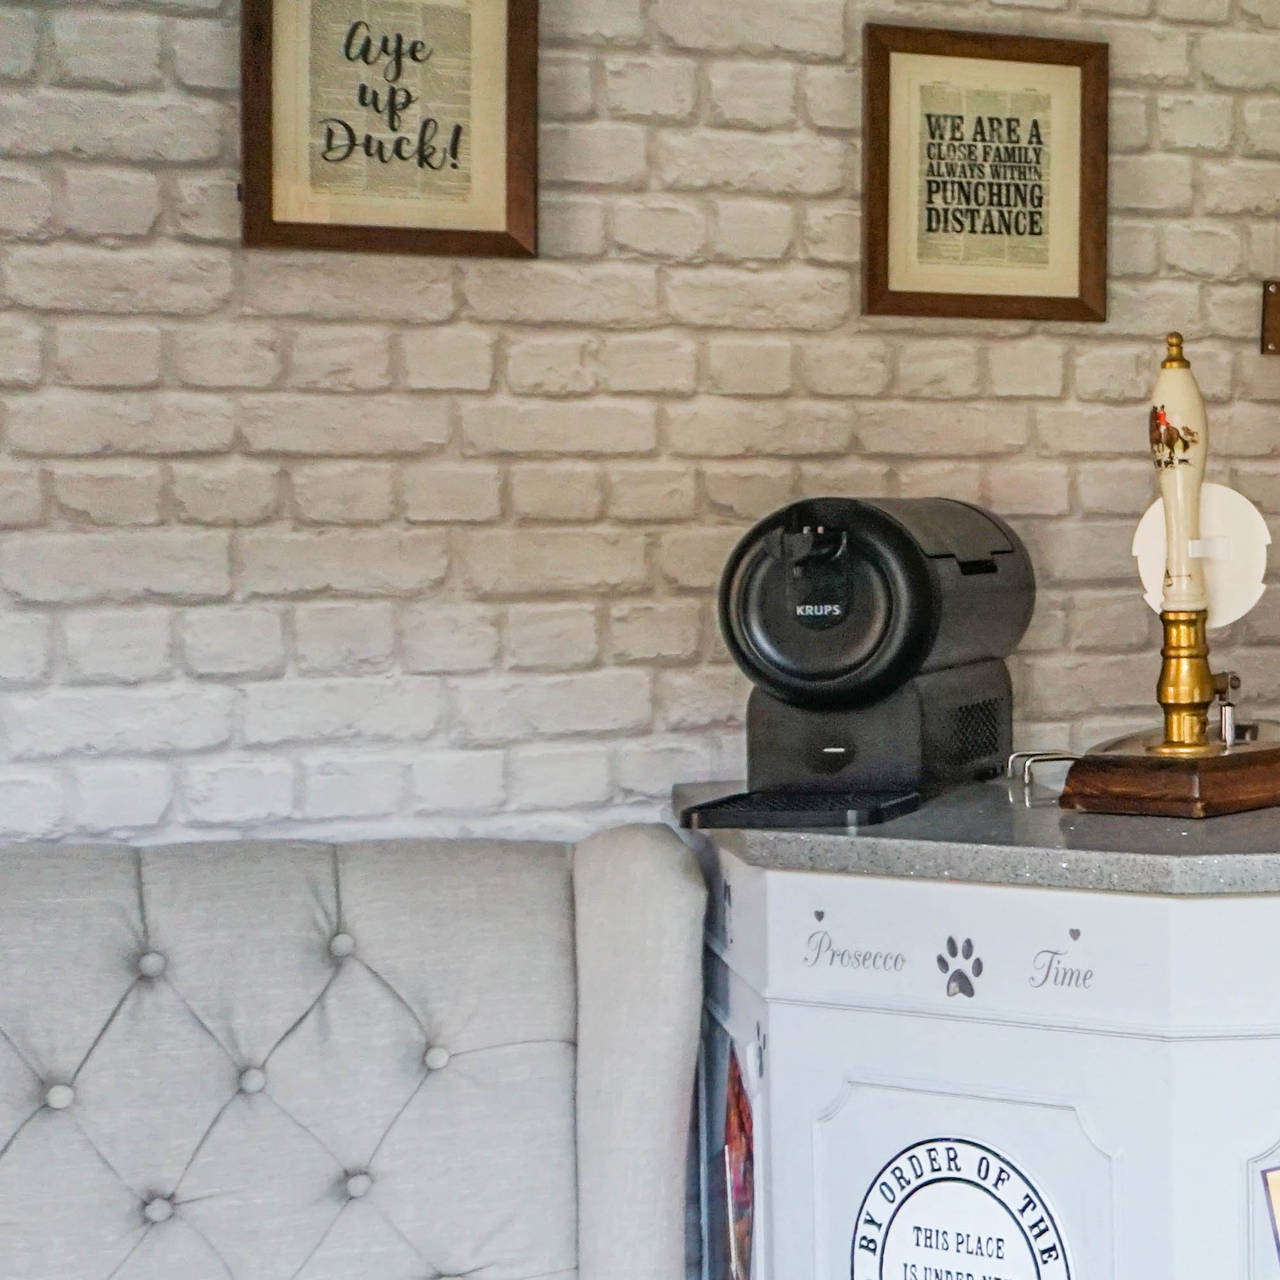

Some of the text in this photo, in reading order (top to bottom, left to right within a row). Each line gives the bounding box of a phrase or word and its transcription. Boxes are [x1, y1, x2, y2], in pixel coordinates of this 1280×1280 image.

[358, 83, 416, 130] up
[319, 117, 462, 171] Duck!
[925, 113, 1044, 146] WE ARE A
[926, 141, 1043, 166] CLOSE FAMILY
[926, 161, 1042, 183] ALWAYS WITHIN
[926, 180, 1044, 209] PUNCHING
[925, 206, 1044, 237] DISTANCE
[795, 603, 841, 617] KRUPS
[804, 930, 1095, 990] Prosecco Time
[858, 1146, 1060, 1266] BY ORDER OF THE
[912, 1226, 1005, 1260] THIS PLACE
